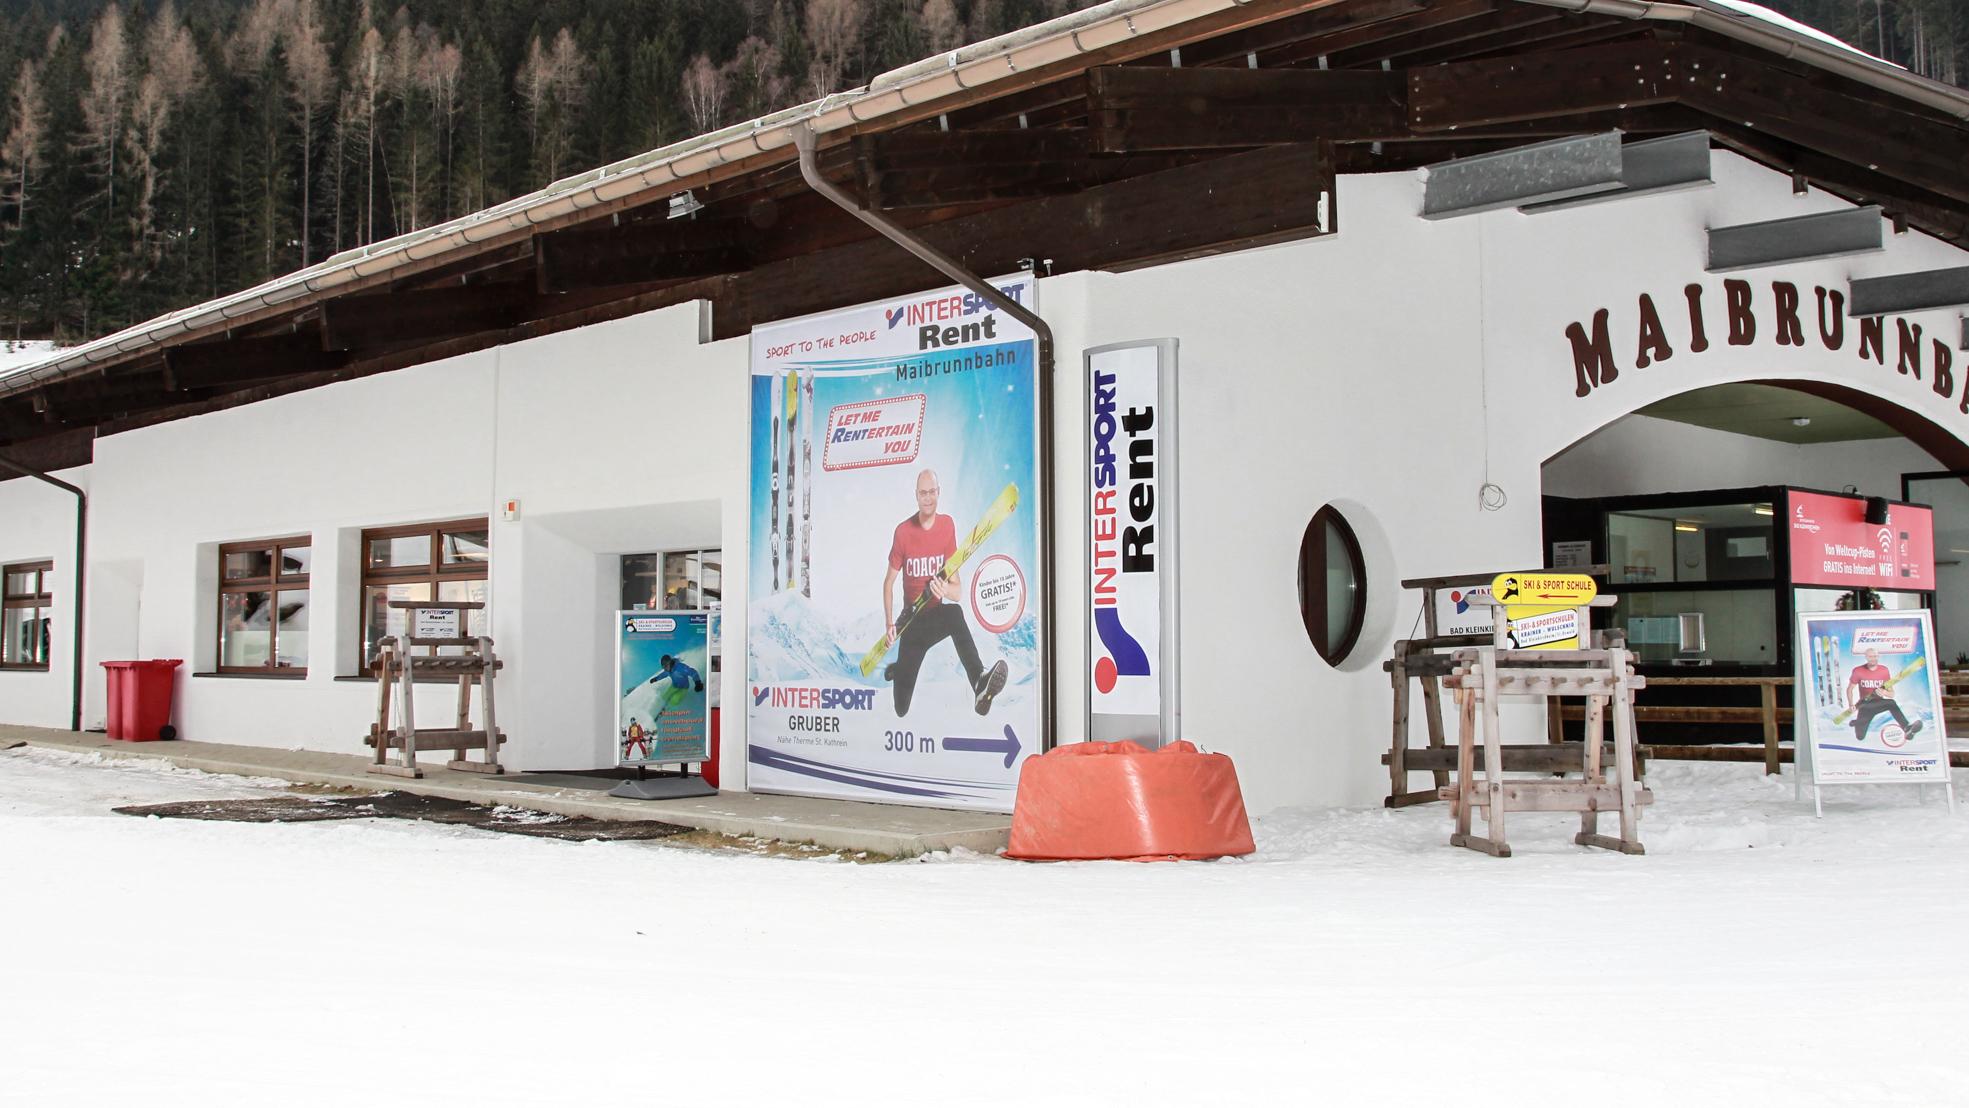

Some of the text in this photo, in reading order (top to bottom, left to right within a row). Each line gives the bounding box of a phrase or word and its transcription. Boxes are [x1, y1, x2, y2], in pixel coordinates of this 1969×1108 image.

[919, 313, 996, 350] Rent
[766, 330, 876, 359] SPORT TO THE PEOPLE
[1565, 278, 1969, 415] MAIBRUNNB
[896, 348, 1016, 382] Maibrunnbahn
[837, 410, 881, 427] LET ME
[884, 440, 911, 454] YOU
[1094, 369, 1117, 605] INTERSPORT
[1121, 405, 1154, 573] Rent
[906, 554, 944, 577] COACH
[1823, 561, 1843, 573] GRATIS
[1523, 581, 1592, 590] SKI & SPORT SCHULE
[1465, 625, 1494, 634] KLEINKI
[772, 687, 875, 710] INTERSPORT
[788, 715, 840, 733] GRUBER
[884, 730, 935, 753] 300 m
